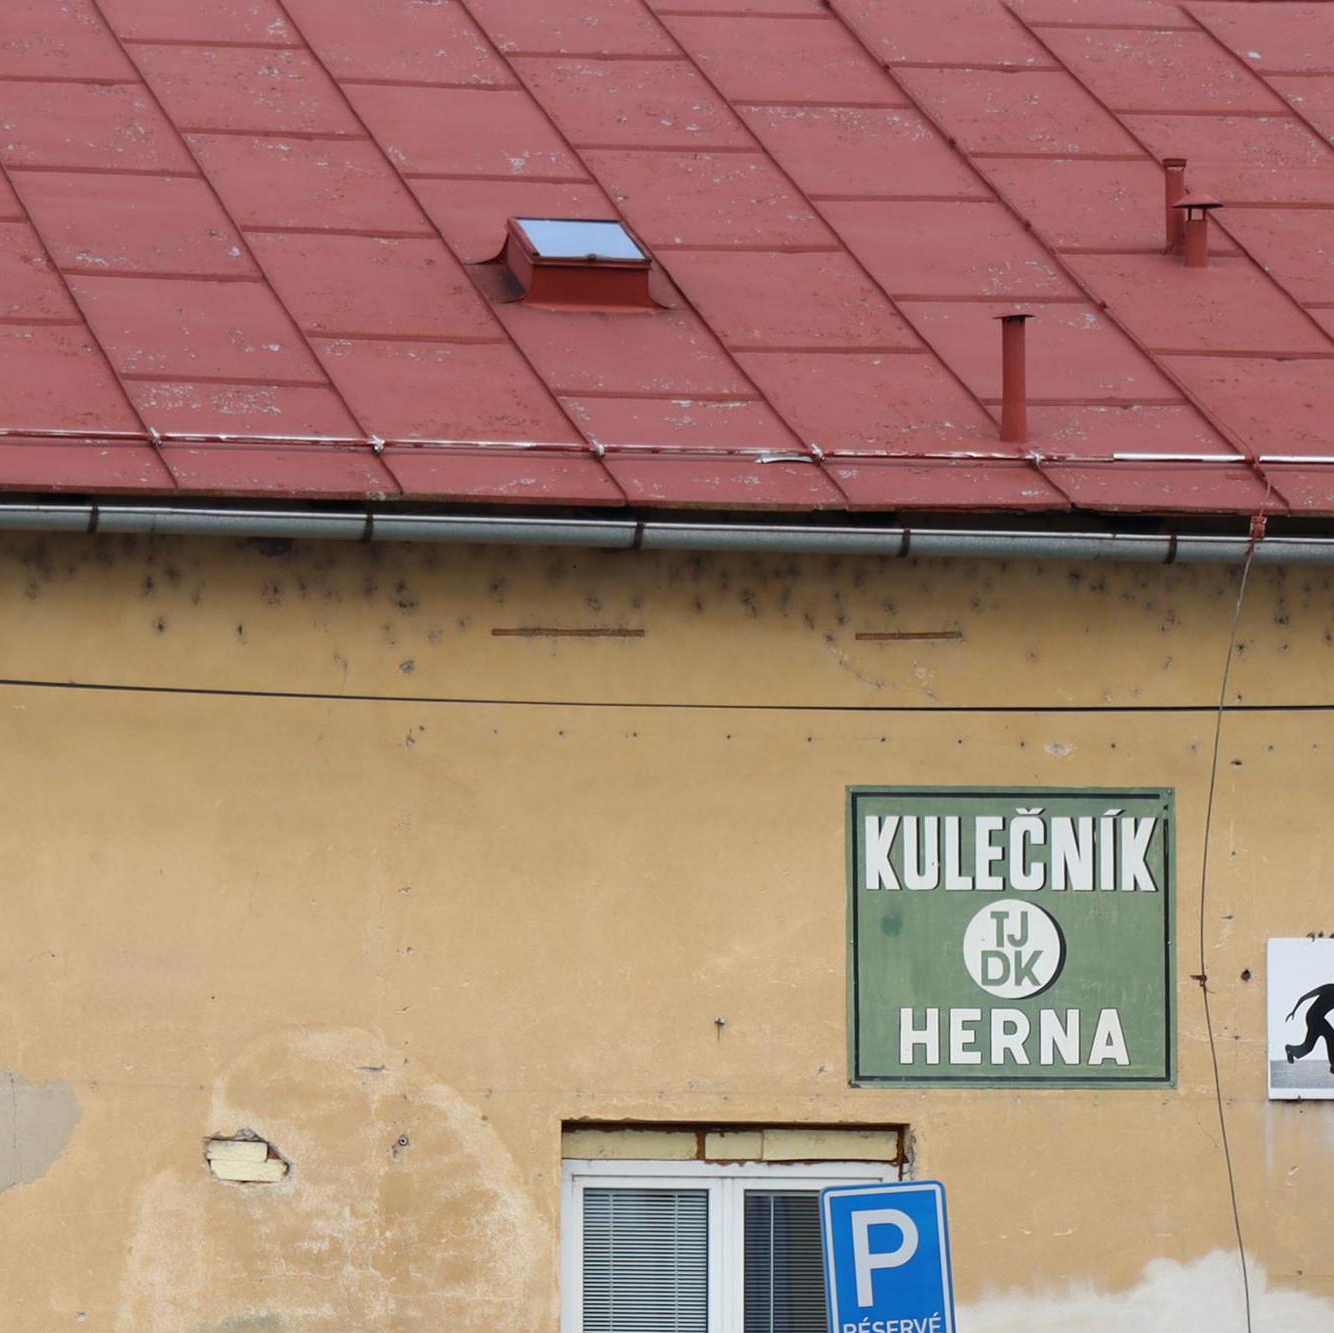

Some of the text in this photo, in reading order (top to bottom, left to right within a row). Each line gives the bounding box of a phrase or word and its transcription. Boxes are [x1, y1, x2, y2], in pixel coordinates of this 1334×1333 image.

[865, 807, 1159, 893] KULEČNÍK
[990, 911, 1029, 948] TJ
[980, 950, 1044, 986] DK
[898, 1007, 1131, 1066] HERNA
[851, 1208, 919, 1308] P
